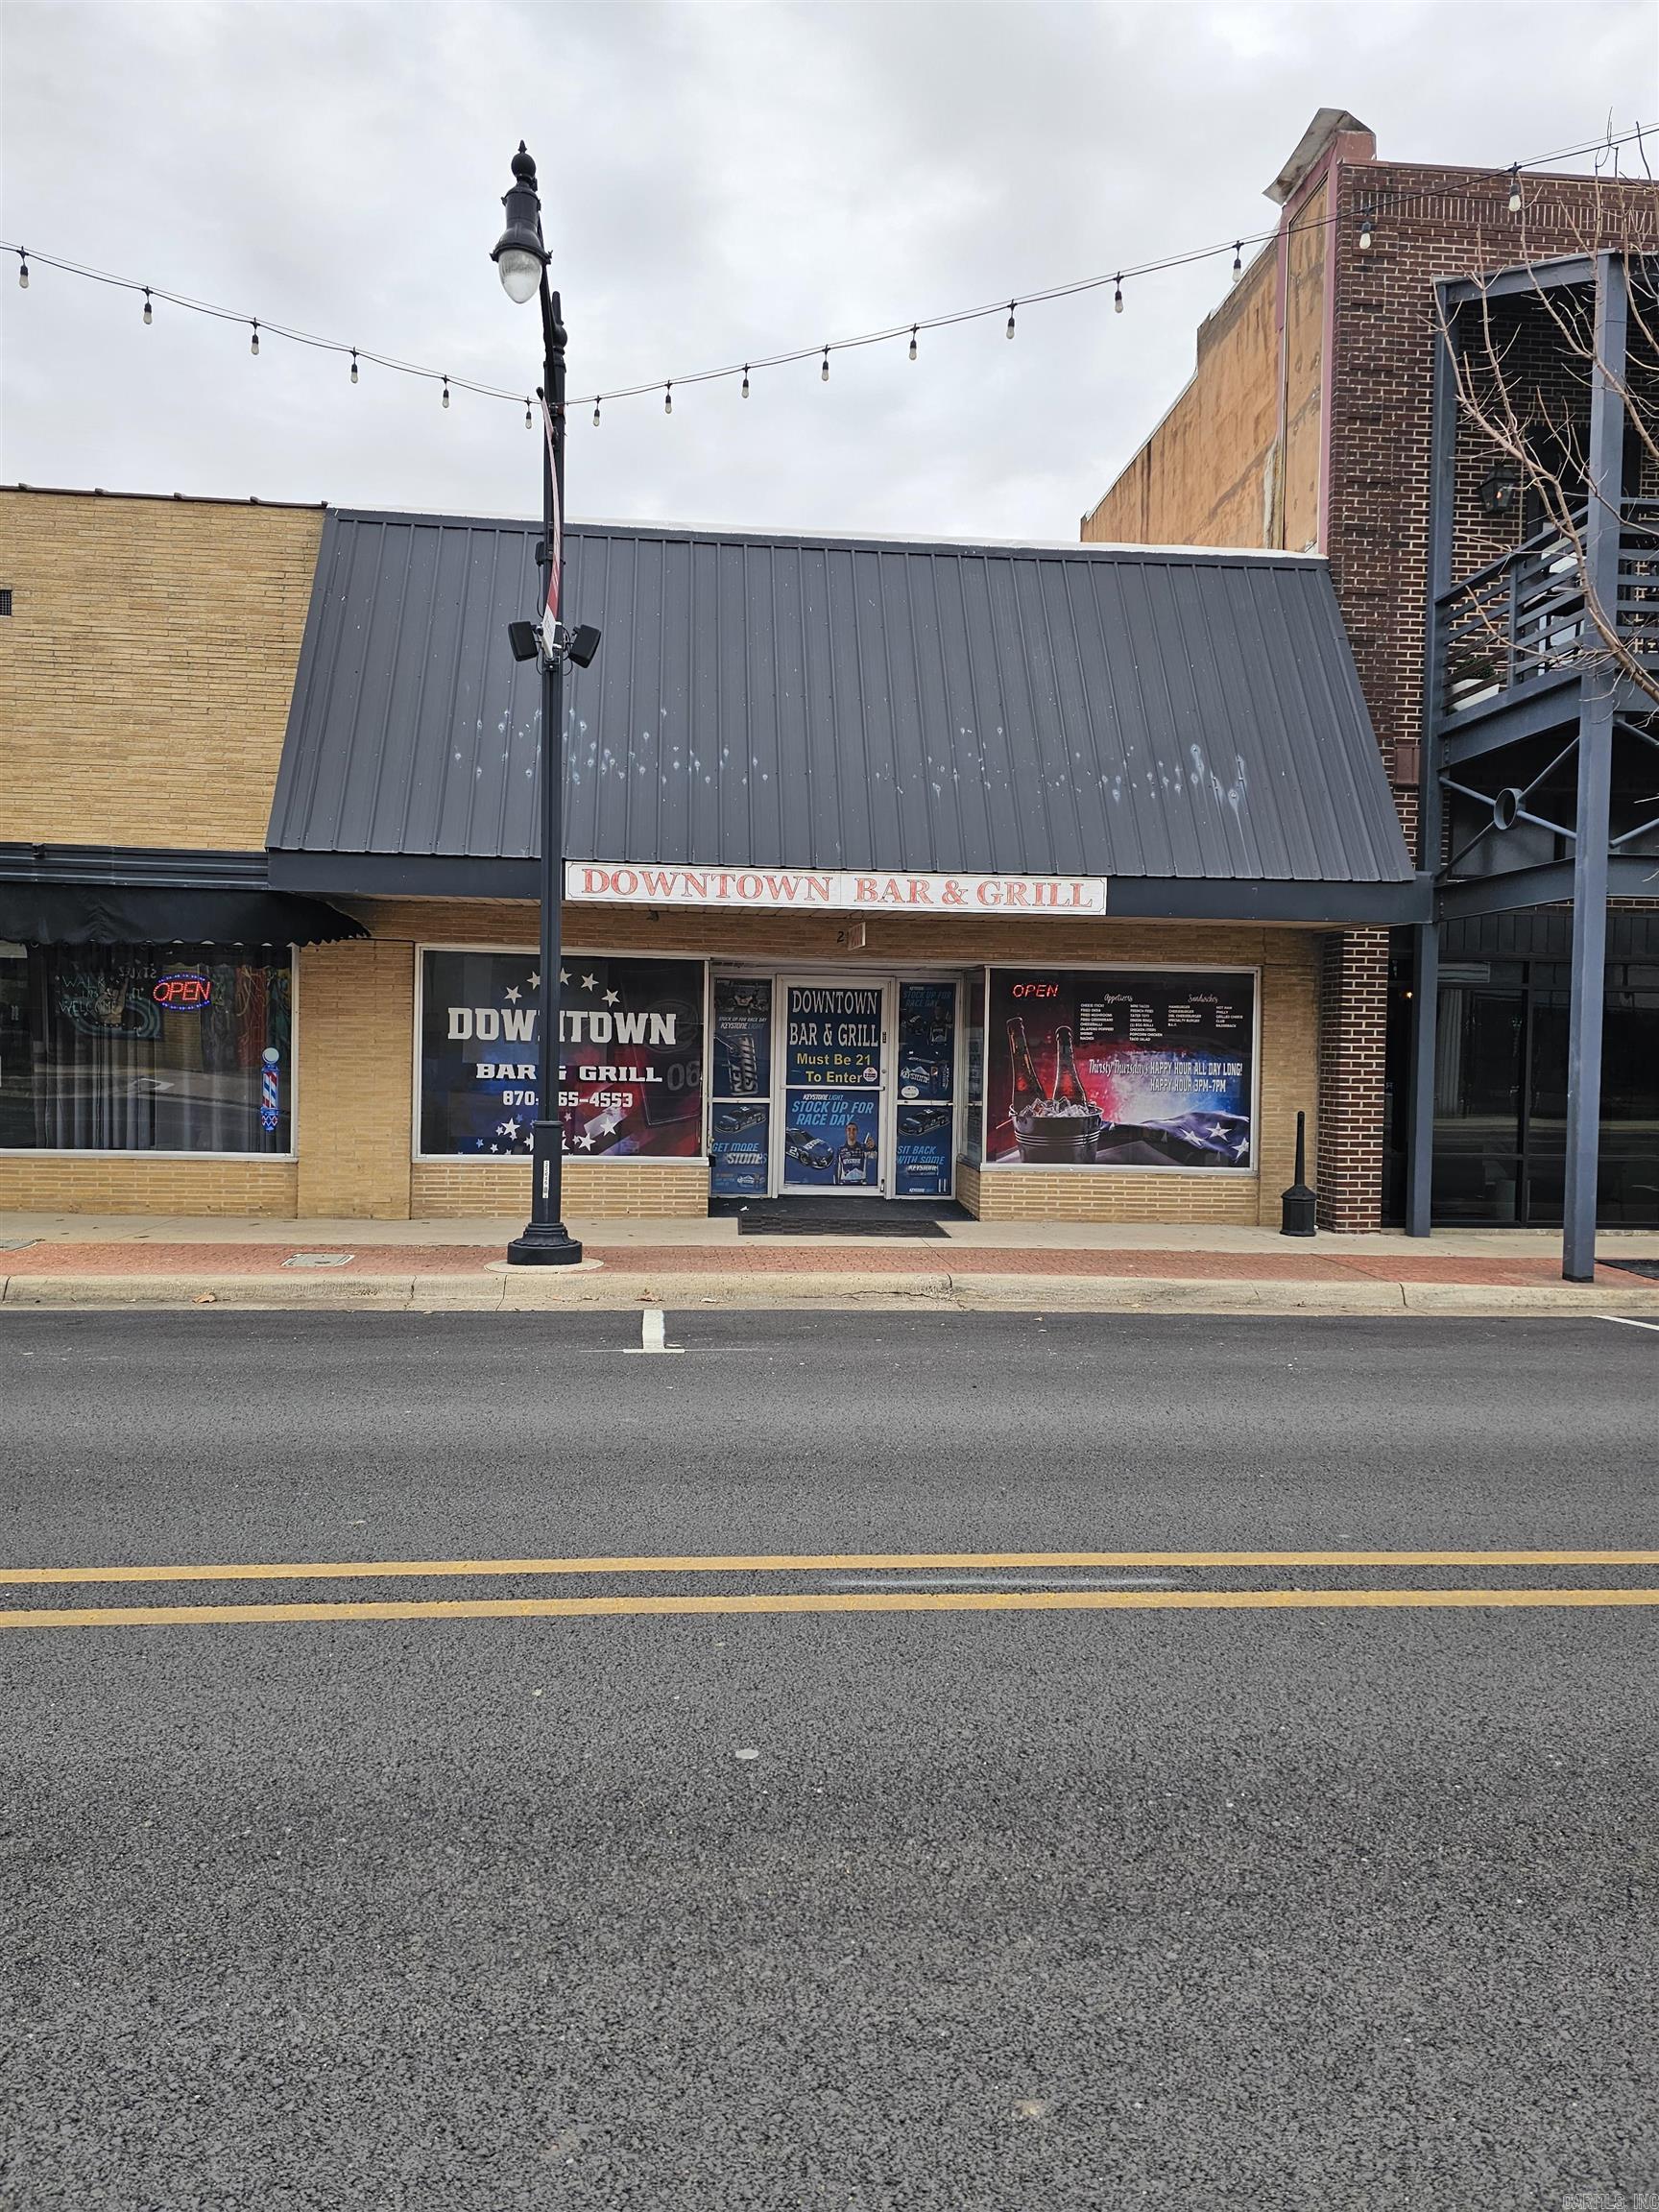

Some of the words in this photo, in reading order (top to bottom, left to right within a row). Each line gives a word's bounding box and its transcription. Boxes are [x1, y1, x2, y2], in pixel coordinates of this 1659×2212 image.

[582, 868, 833, 902] DOWNTOWN
[854, 878, 934, 904] BAR
[941, 879, 968, 905] &
[976, 880, 1093, 907] GRILL
[153, 981, 211, 1002] OPEN
[1012, 984, 1059, 998] OPEN
[792, 990, 878, 1015] DOWNTOWN
[447, 1007, 677, 1046] DOWTOWN
[789, 1022, 818, 1046] BAR
[823, 1022, 832, 1046] &
[838, 1023, 878, 1047] GRILL
[797, 1053, 830, 1065] Must
[834, 1053, 852, 1066] Be
[855, 1054, 871, 1066] 21
[475, 1063, 538, 1081] BAR
[579, 1066, 663, 1083] GRILL
[1089, 1059, 1113, 1077] Thirsty
[1150, 1061, 1172, 1074] HAPPY
[1173, 1061, 1192, 1075] HOUR
[1194, 1062, 1207, 1075] ALL
[1209, 1062, 1222, 1076] DAY
[1222, 1062, 1243, 1076] LONG!
[805, 1070, 822, 1083] To
[827, 1070, 862, 1083] Enter
[1150, 1078, 1172, 1092] HAPPY
[1174, 1078, 1192, 1092] HOUR
[1194, 1078, 1227, 1093] 3PM-7PM
[792, 1100, 830, 1113] STOCK
[831, 1101, 849, 1114] UP
[851, 1101, 875, 1114] FOR
[796, 1113, 828, 1125] RACE
[830, 1114, 854, 1126] DAY
[712, 1142, 730, 1152] GET
[731, 1142, 759, 1152] MORE
[898, 1145, 911, 1154] SIT
[912, 1145, 937, 1155] BACK
[897, 1155, 918, 1165] WITH
[920, 1156, 946, 1165] SOME
